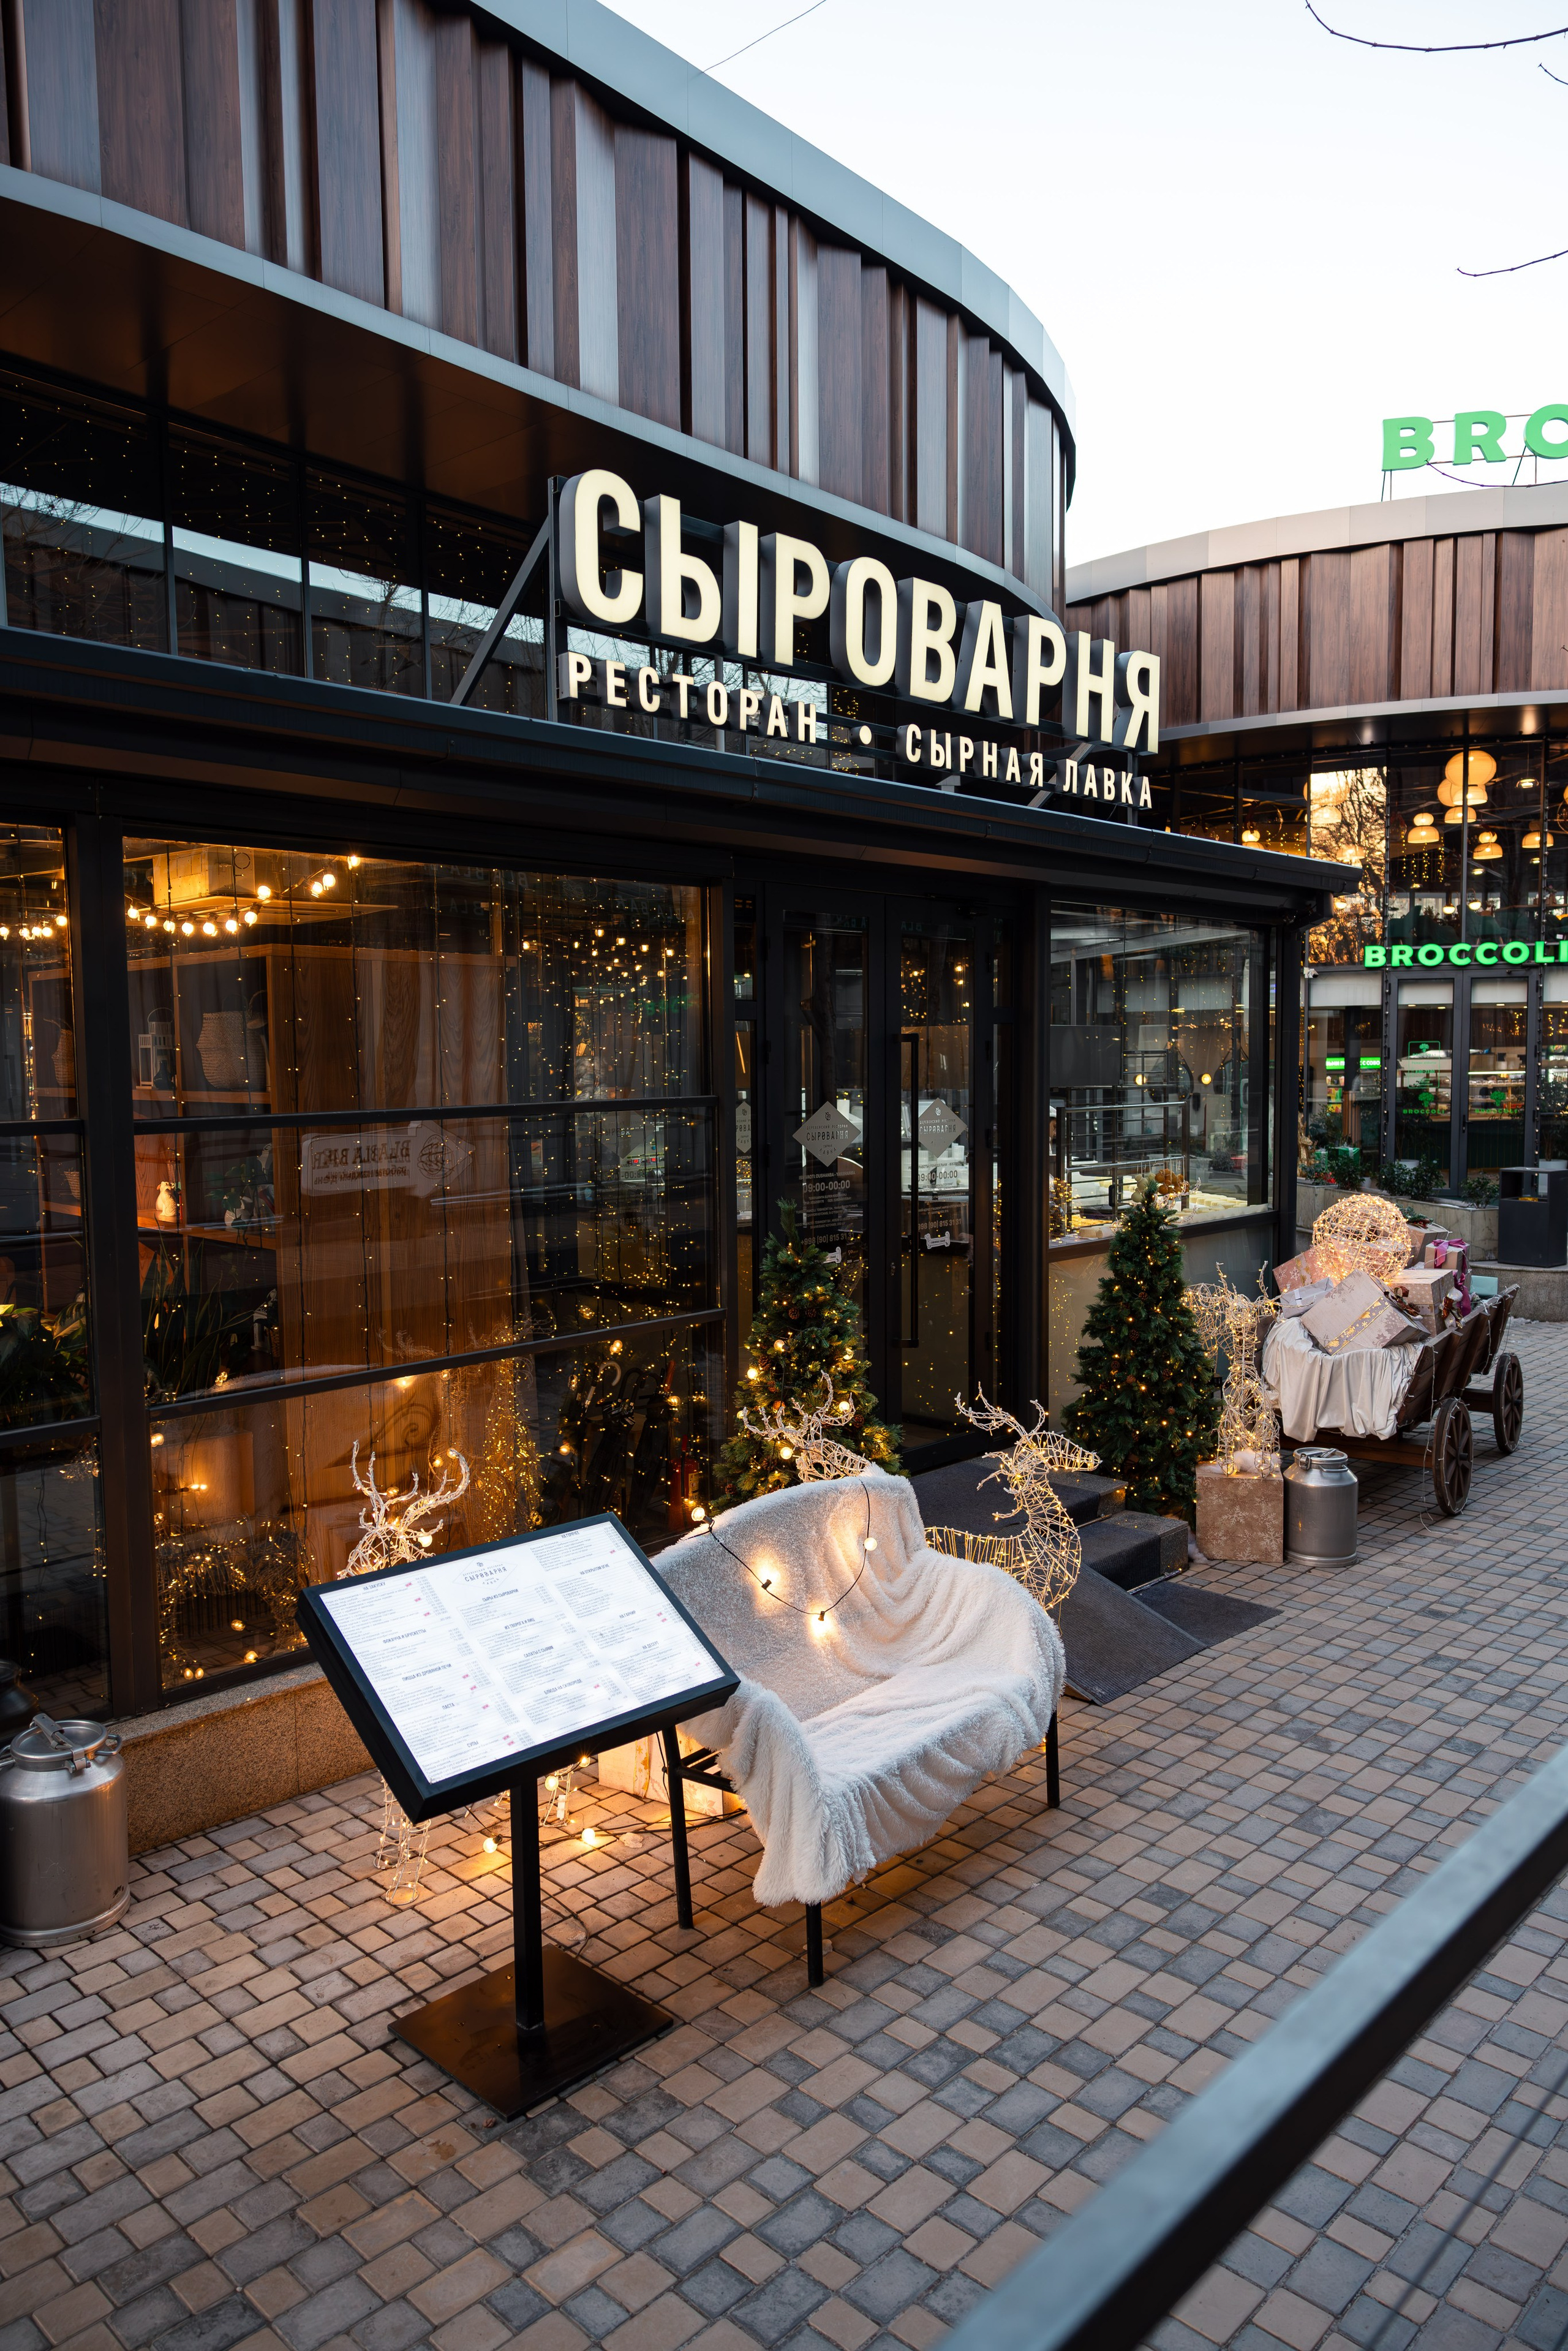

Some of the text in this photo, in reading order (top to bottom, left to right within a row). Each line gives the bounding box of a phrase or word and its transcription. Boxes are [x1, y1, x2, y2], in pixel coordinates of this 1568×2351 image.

[1381, 404, 1568, 472] BRO
[570, 469, 1161, 757] СЫРОВАРНЯ
[567, 651, 1152, 809] РЕСТОРАН СЫРНАЯ ЛАВКА
[1364, 940, 1568, 968] BROCCOLI
[806, 1130, 848, 1141] СЫРОВАРНЯ
[802, 1180, 850, 1193] 09:00-00:00
[801, 1236, 816, 1245] +998
[816, 1234, 829, 1245] (90)
[829, 1234, 840, 1242] 815
[464, 1566, 507, 1582] СЫРОВАРНЯ
[382, 1636, 401, 1644] ФОКАЧЧА
[404, 1628, 426, 1638] БРУСКЕТТЫ
[421, 1666, 442, 1676] ДРОВЯНОЙ
